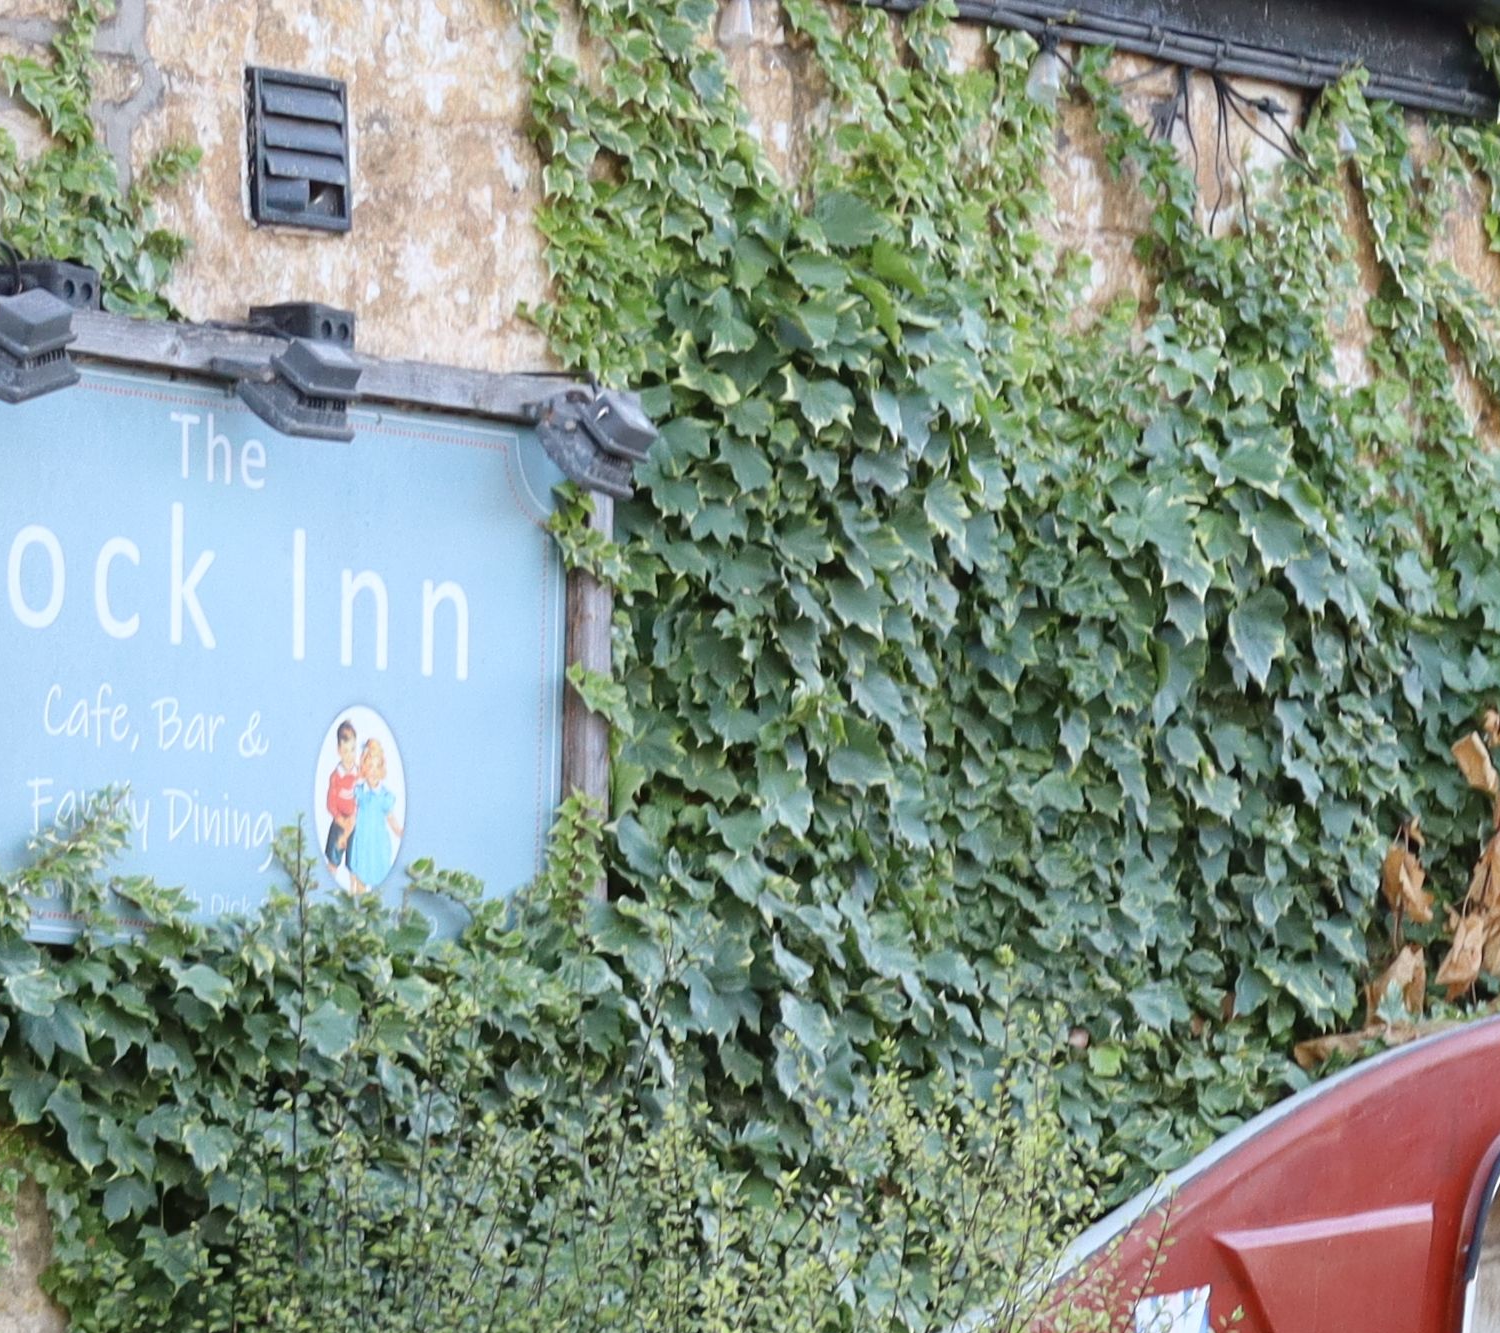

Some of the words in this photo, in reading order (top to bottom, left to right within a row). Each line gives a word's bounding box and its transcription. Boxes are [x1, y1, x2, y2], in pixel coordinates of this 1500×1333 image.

[170, 412, 267, 489] The
[291, 528, 470, 681] Inn
[44, 683, 140, 753] Cafe,
[151, 696, 225, 753] Bar
[238, 710, 269, 758] &
[162, 787, 275, 873] Dining
